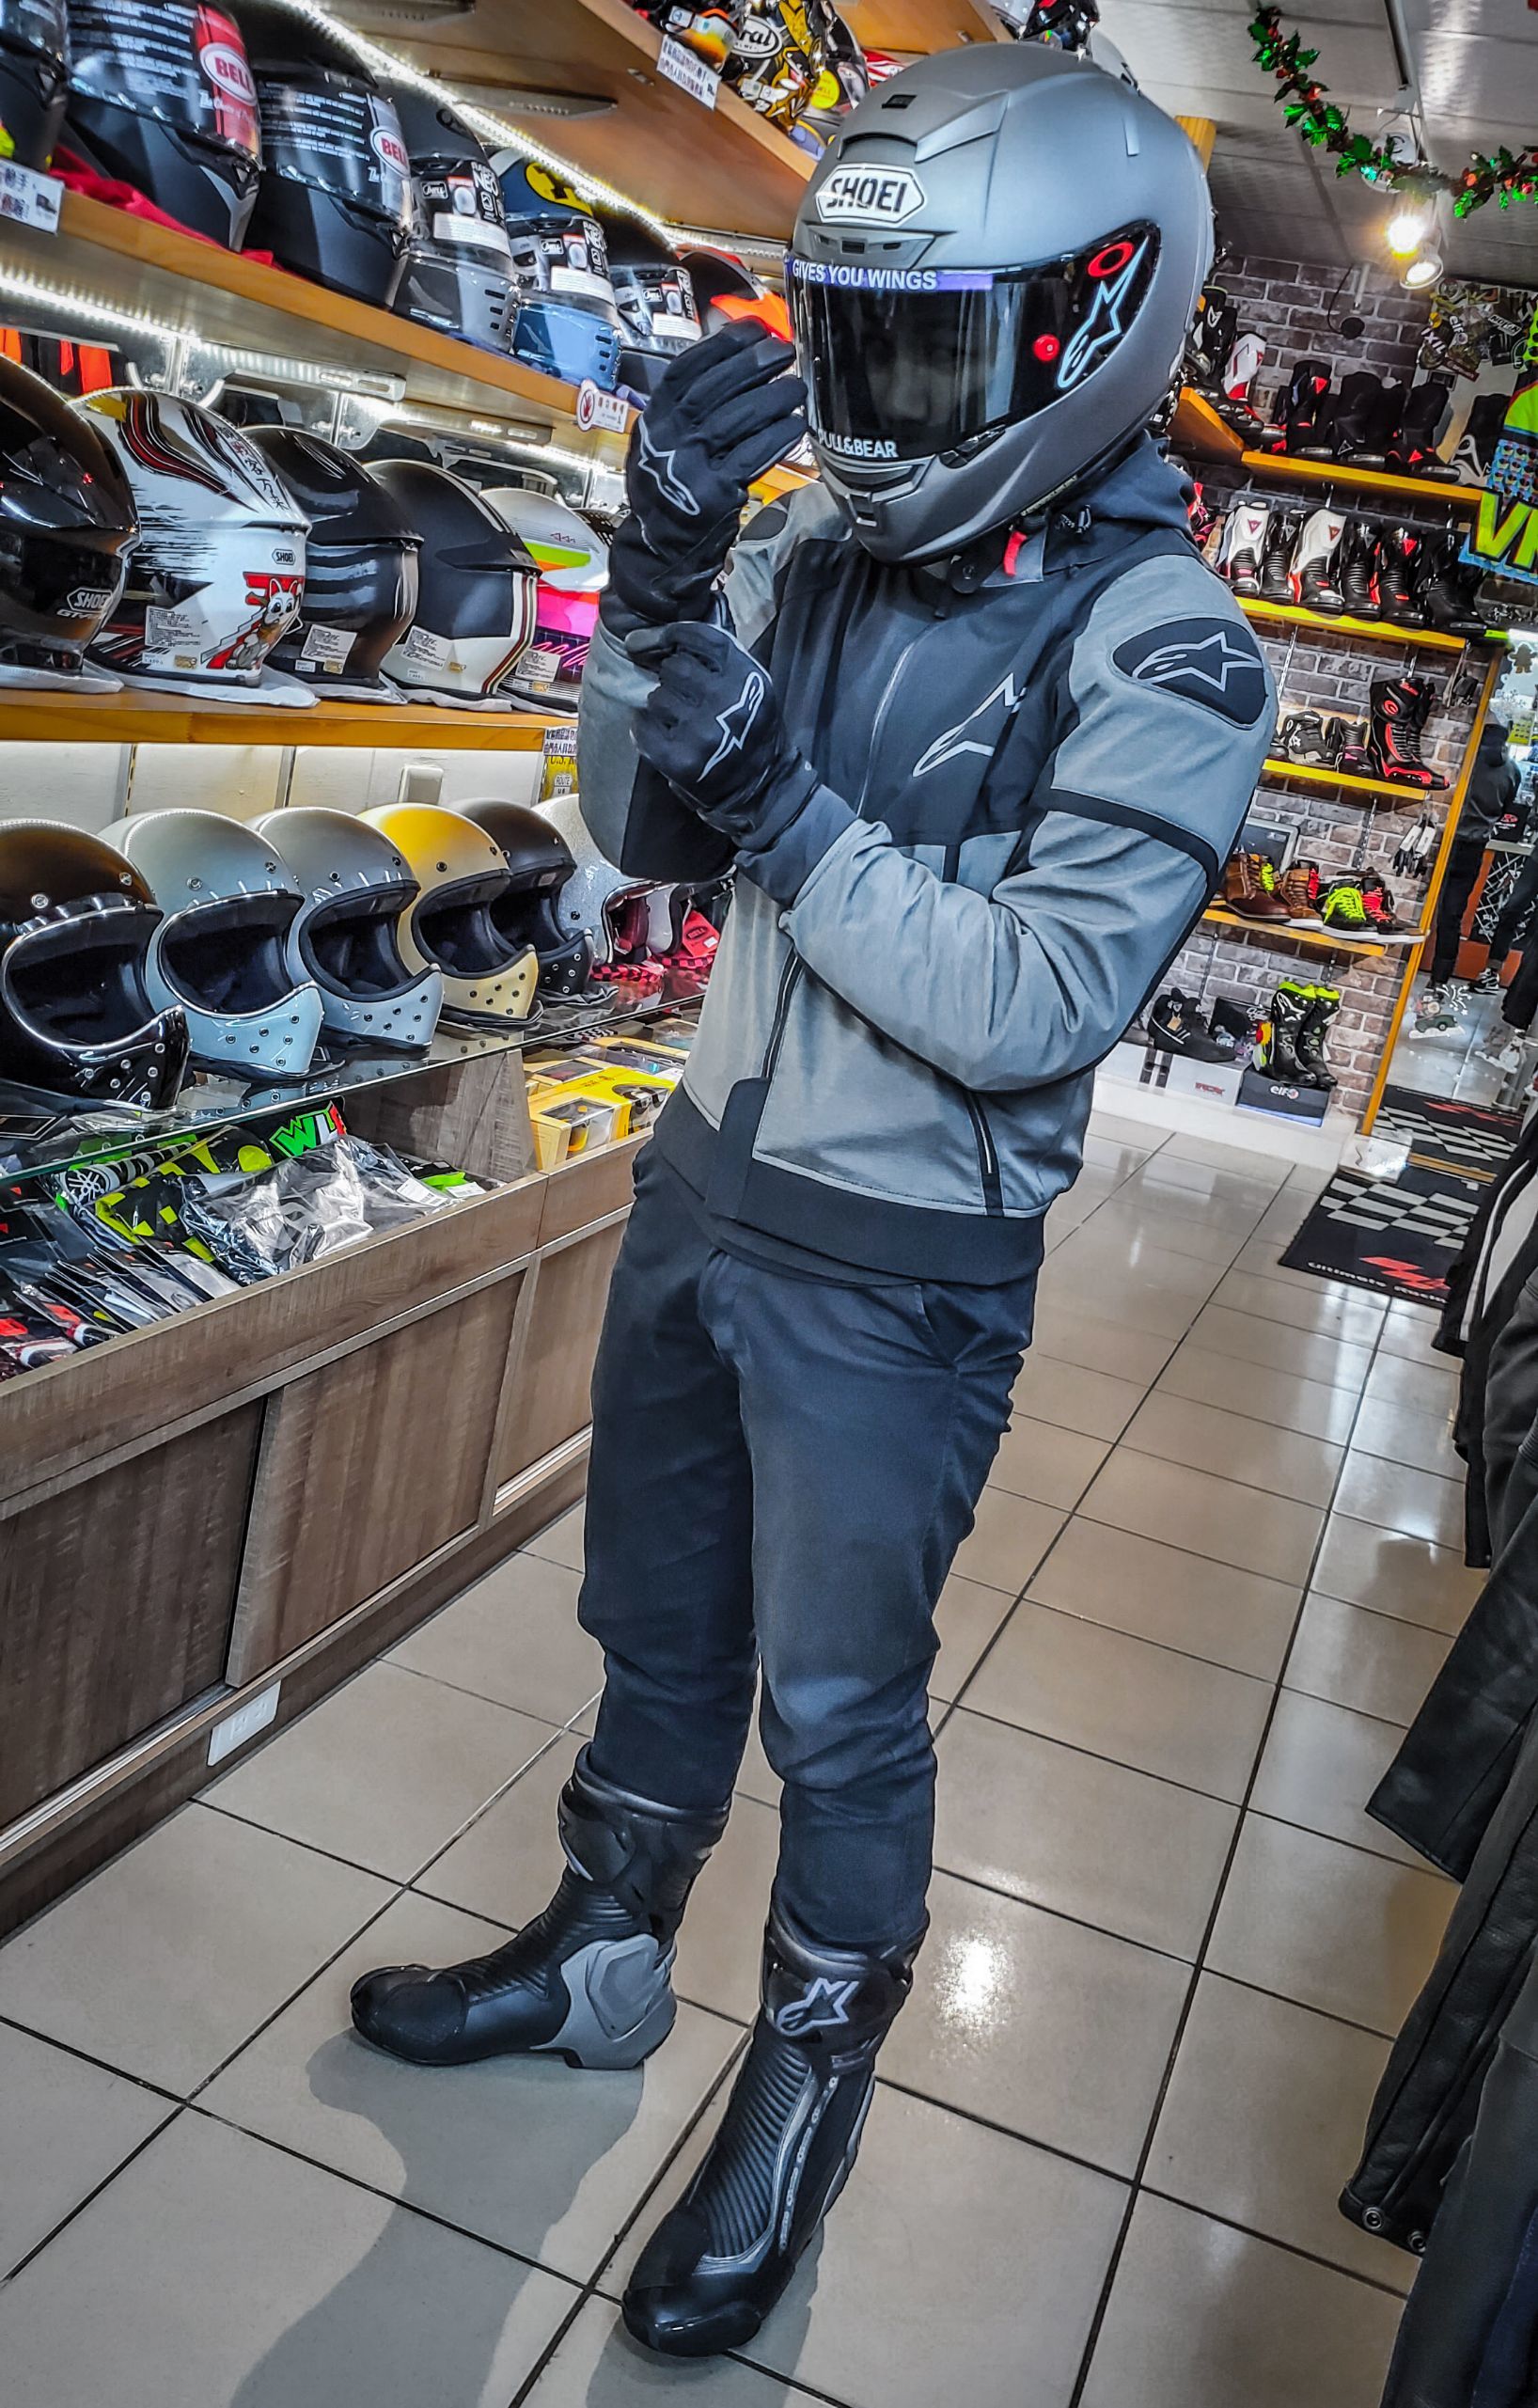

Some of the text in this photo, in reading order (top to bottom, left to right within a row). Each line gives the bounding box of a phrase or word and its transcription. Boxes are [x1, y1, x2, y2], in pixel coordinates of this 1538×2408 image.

[214, 56, 254, 96] BELL
[826, 177, 907, 212] SHOEI
[793, 259, 936, 291] GIVES YOU WINGS
[818, 429, 899, 458] PULL&BEAR
[74, 591, 111, 609] SHOE
